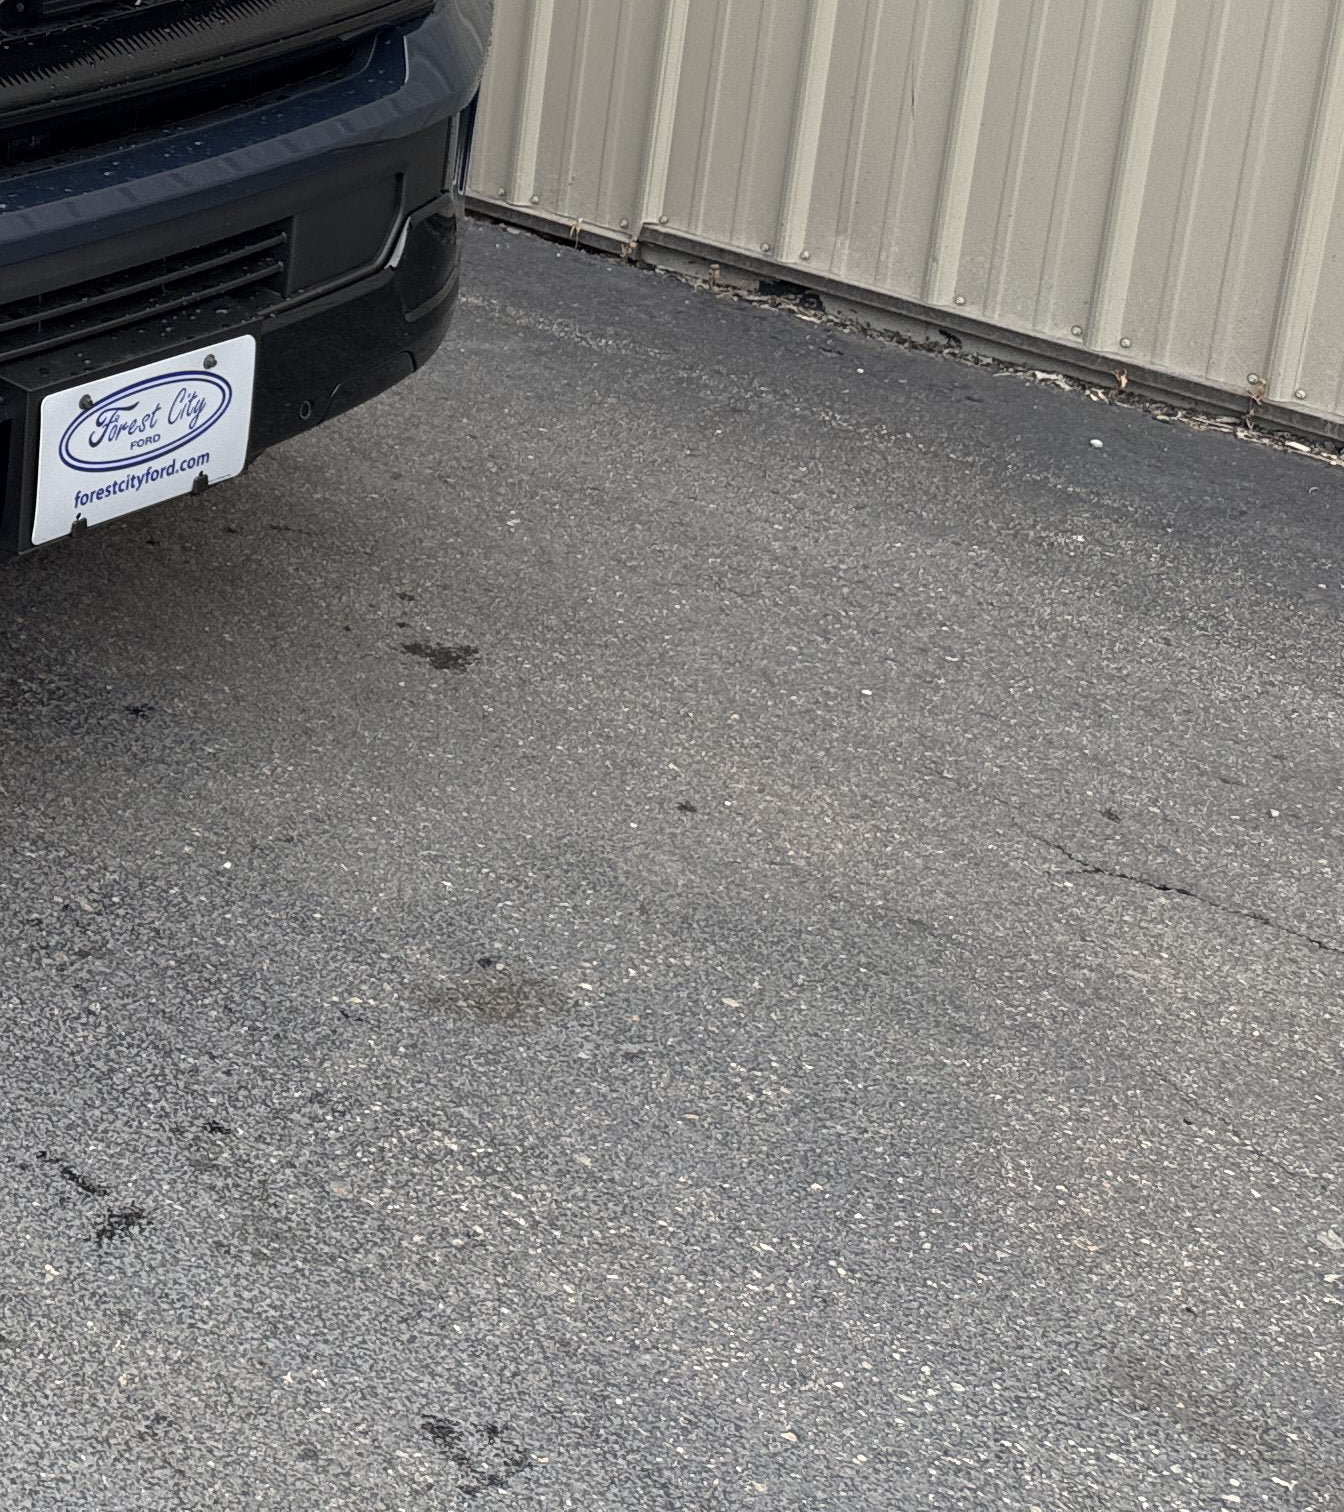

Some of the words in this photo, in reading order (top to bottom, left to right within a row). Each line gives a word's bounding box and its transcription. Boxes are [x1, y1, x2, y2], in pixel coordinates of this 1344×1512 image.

[88, 401, 162, 448] Forest
[167, 387, 207, 430] City
[129, 433, 162, 451] FORD
[74, 451, 210, 509] forestcityford.com
